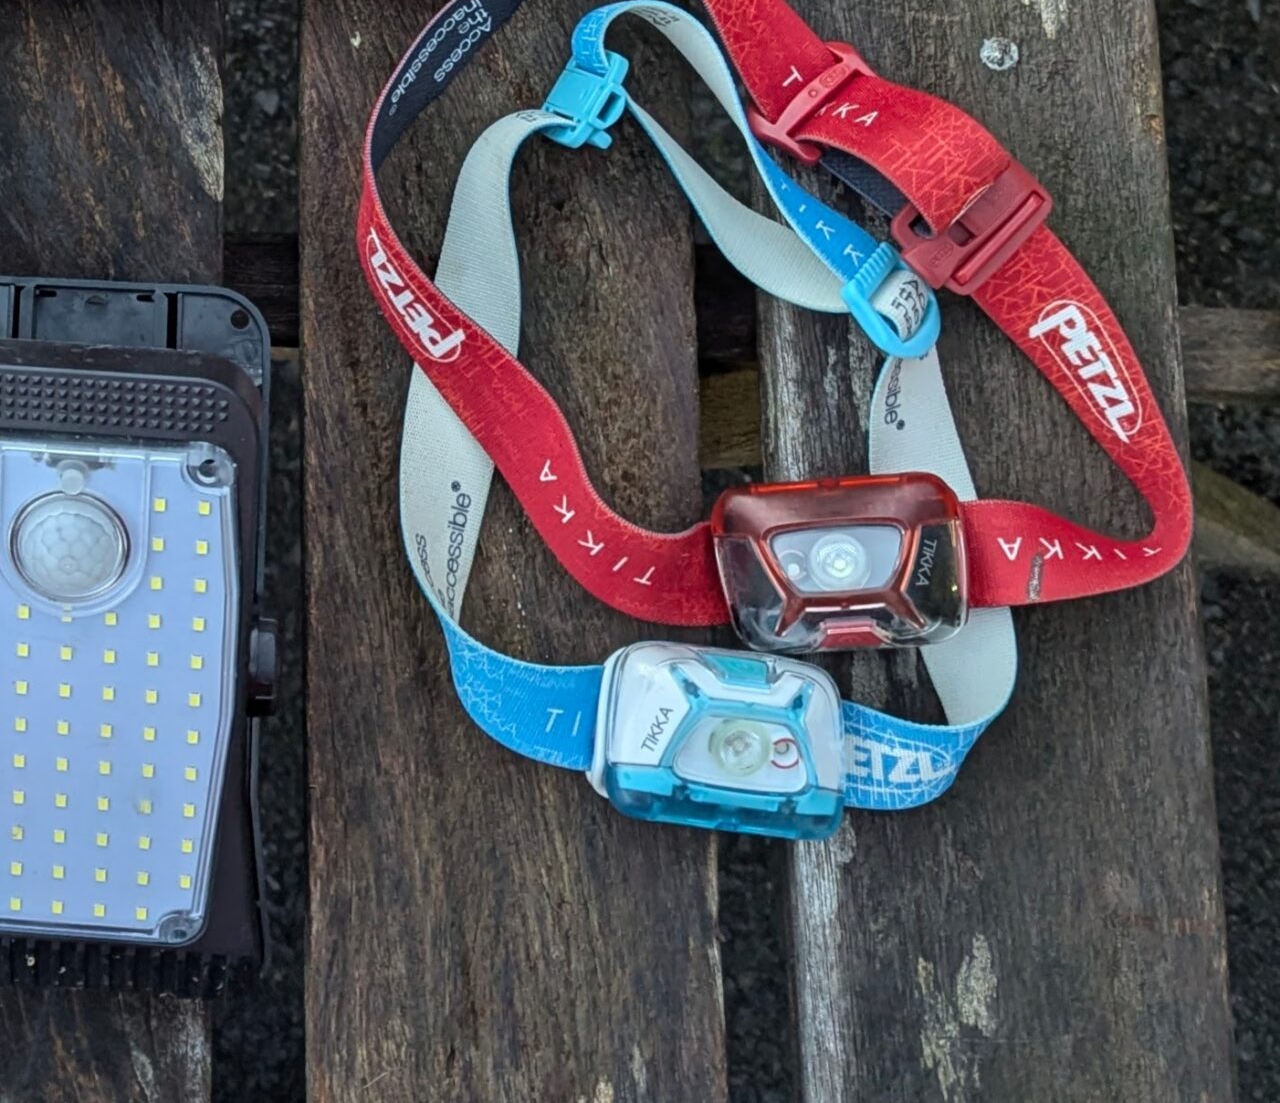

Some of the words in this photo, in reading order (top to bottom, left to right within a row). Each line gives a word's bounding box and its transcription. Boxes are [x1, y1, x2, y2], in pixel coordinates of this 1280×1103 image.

[434, 17, 492, 82] Access
[458, 8, 489, 34] the
[370, 226, 466, 359] PETZL
[1029, 304, 1136, 444] PETZL
[540, 459, 656, 585] TIKKA
[915, 539, 938, 586] TIKKA
[641, 707, 674, 752] TIKKA
[841, 733, 956, 783] ETZL
